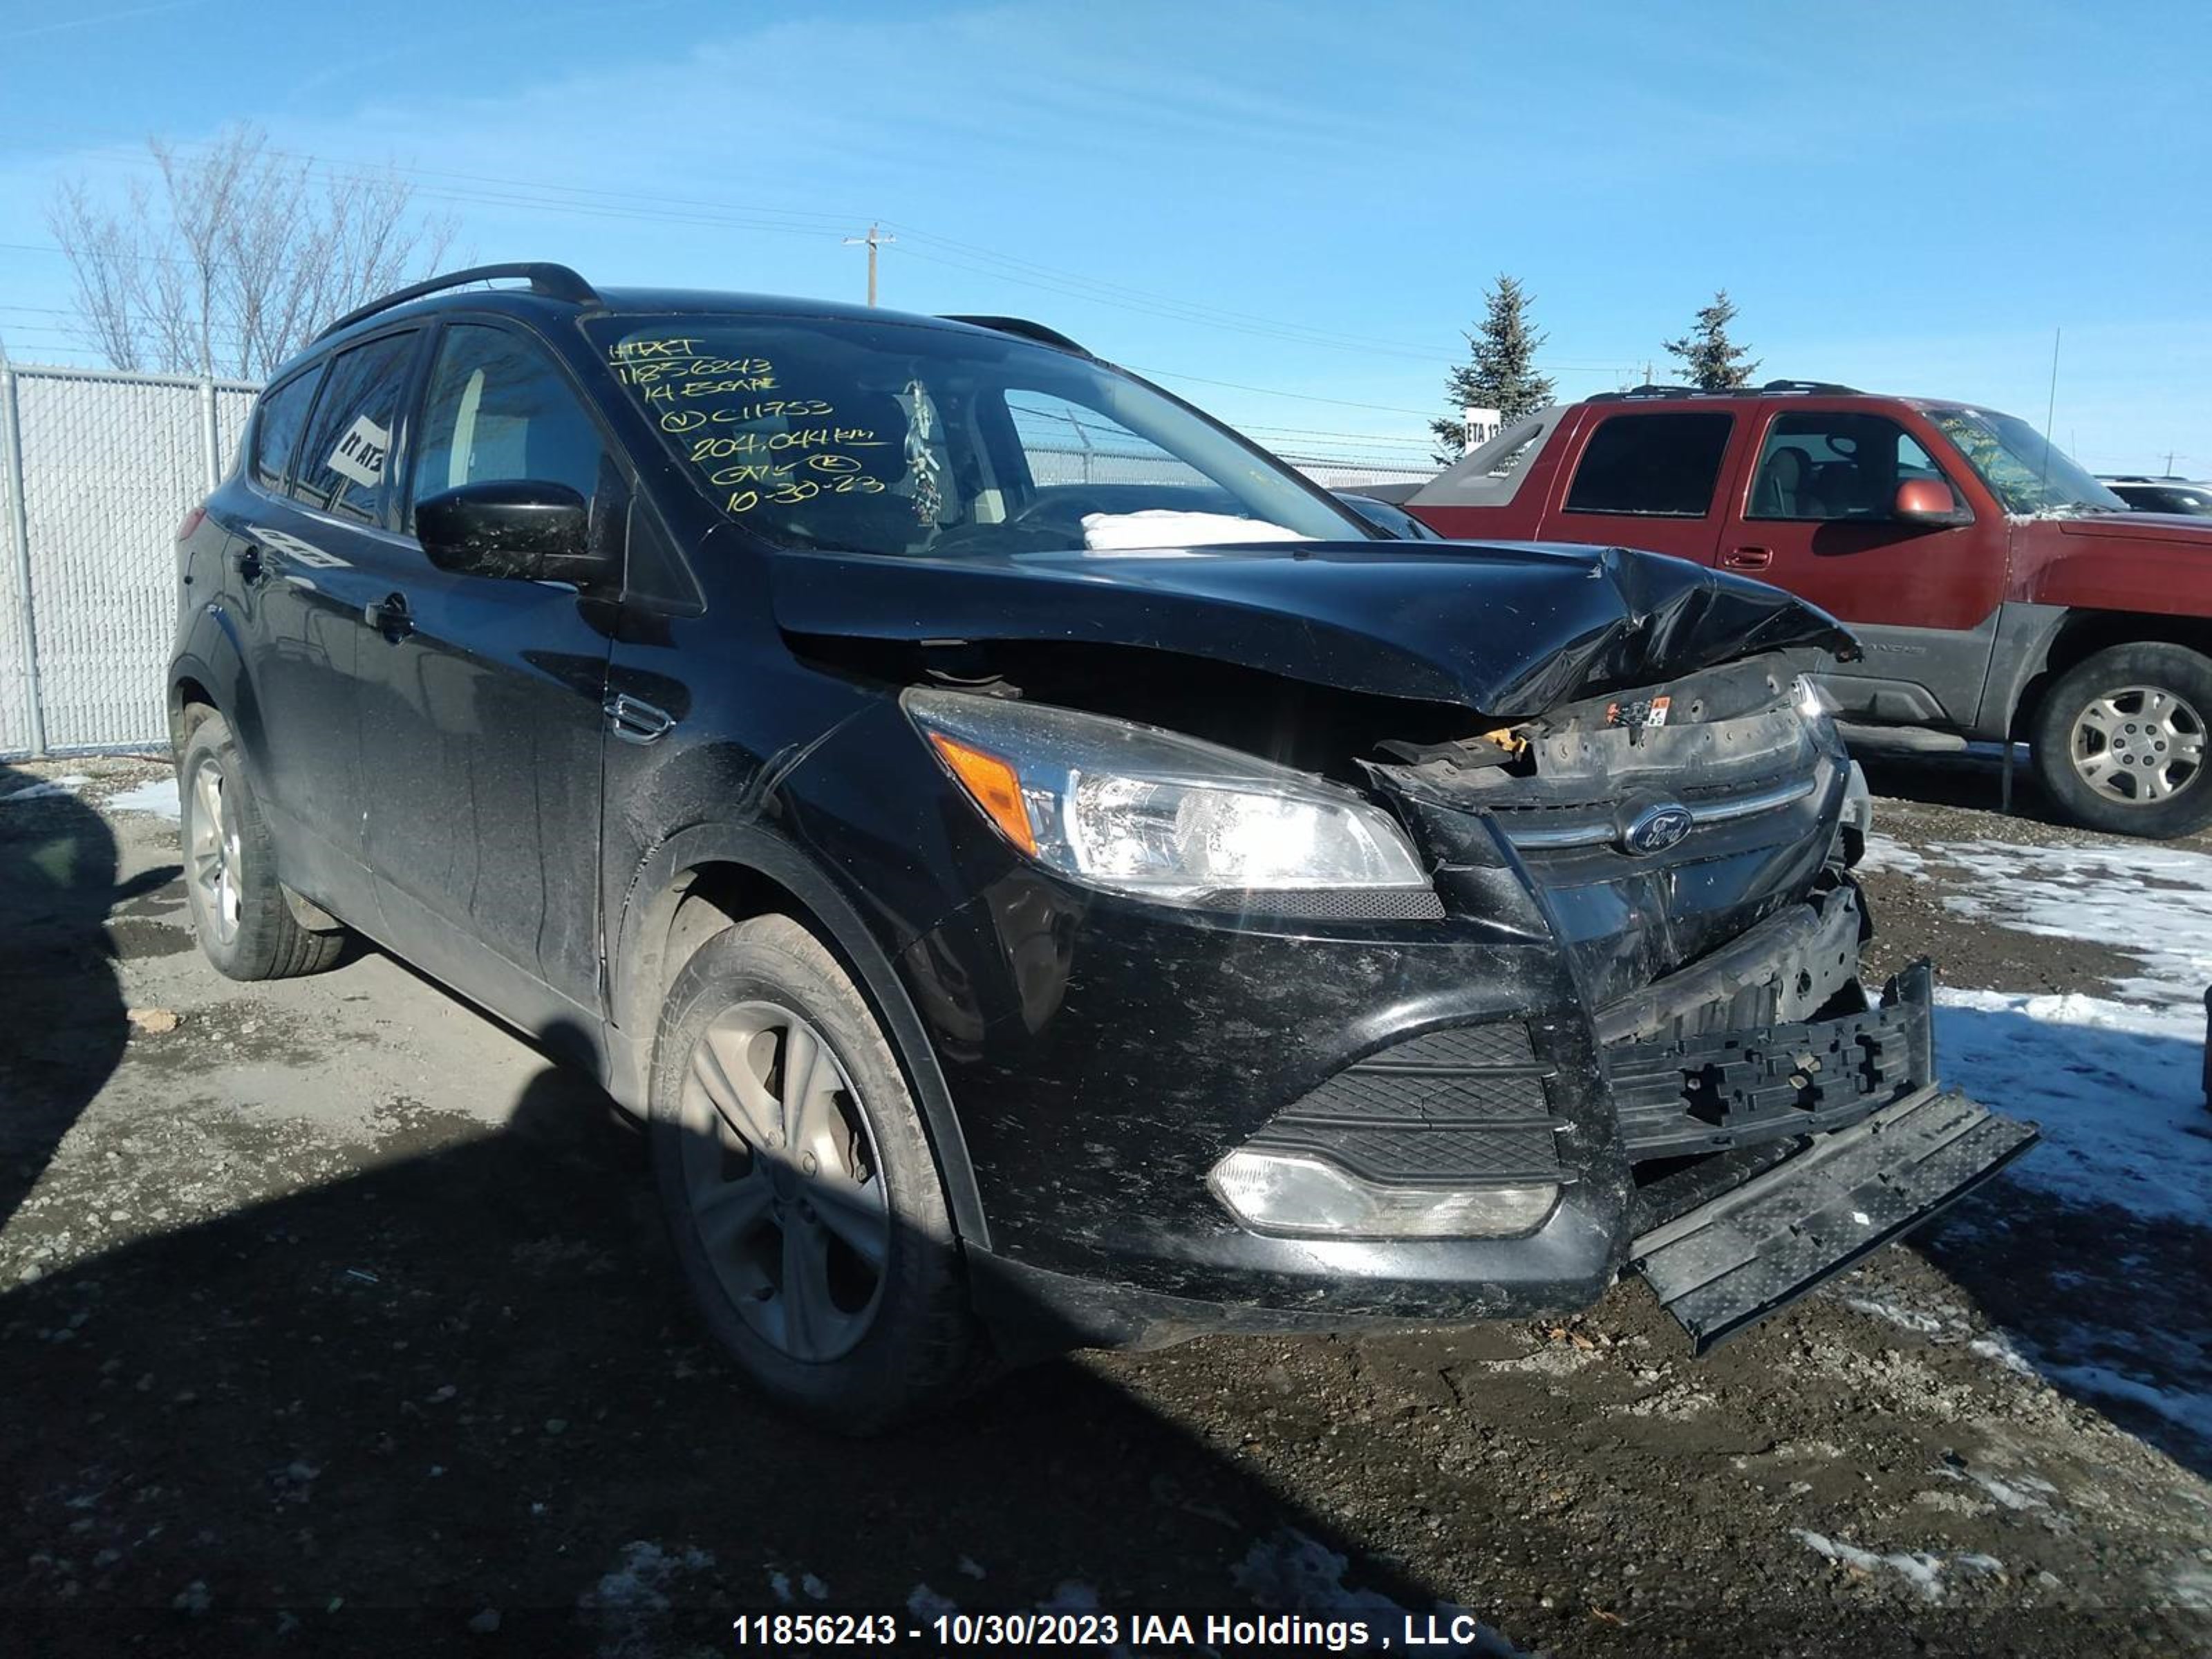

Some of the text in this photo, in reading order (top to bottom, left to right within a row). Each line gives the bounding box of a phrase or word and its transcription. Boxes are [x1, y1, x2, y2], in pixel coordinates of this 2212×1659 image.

[620, 359, 772, 384] 11856243
[645, 378, 780, 403] 14 ESCAPE
[1468, 422, 1484, 442] ETA
[1645, 816, 1685, 848] Ford
